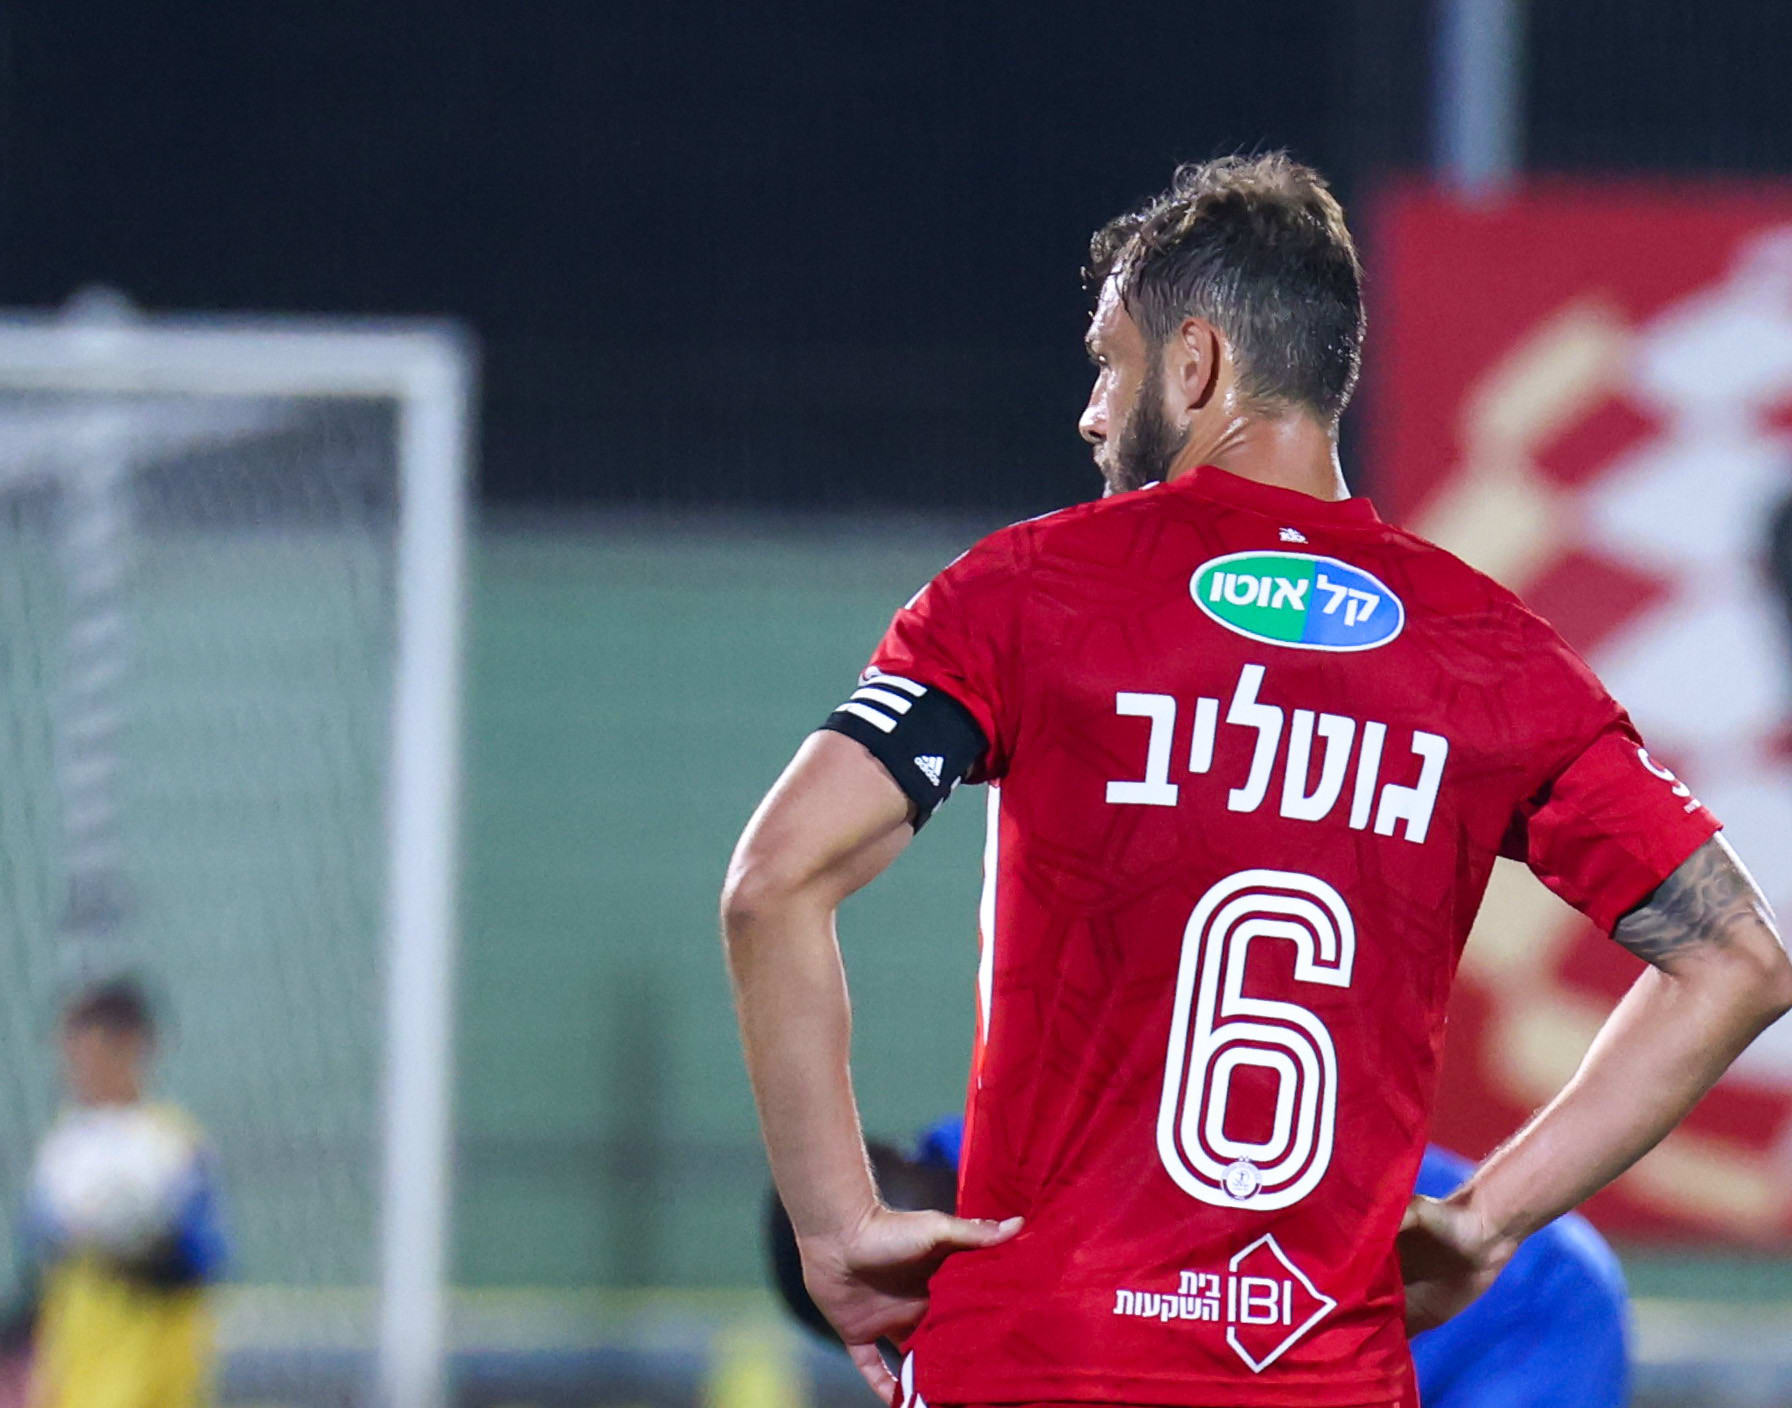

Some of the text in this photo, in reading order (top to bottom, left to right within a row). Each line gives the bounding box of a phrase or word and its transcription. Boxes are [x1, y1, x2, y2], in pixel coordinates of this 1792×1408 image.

[1209, 571, 1380, 627] קל אוטו
[1106, 664, 1447, 843] גוטליב
[1157, 870, 1355, 1210] 6
[1113, 1289, 1220, 1322] השקעות
[1178, 1270, 1221, 1299] בית
[1227, 1276, 1292, 1325] IBI
